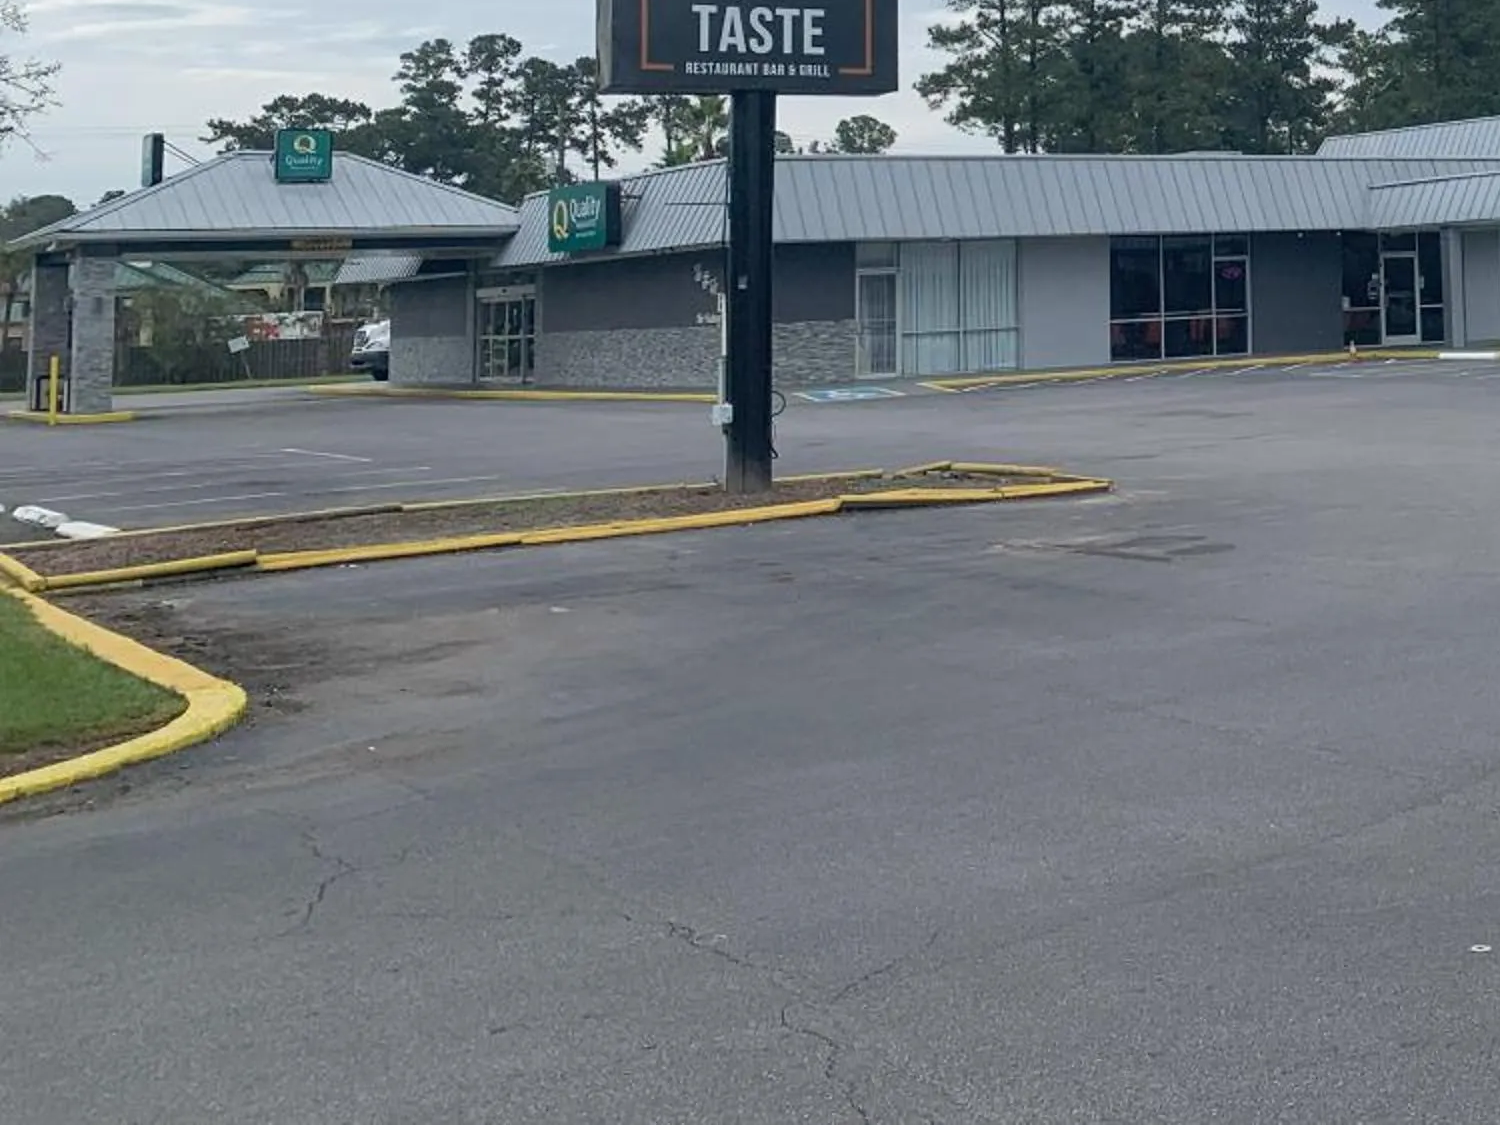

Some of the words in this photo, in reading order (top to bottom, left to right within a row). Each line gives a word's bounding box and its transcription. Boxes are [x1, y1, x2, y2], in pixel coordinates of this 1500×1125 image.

[691, 3, 826, 56] TASTE
[684, 61, 759, 76] RESTAURANT
[763, 62, 785, 76] BAR
[787, 64, 796, 76] &
[799, 63, 831, 78] GRILL
